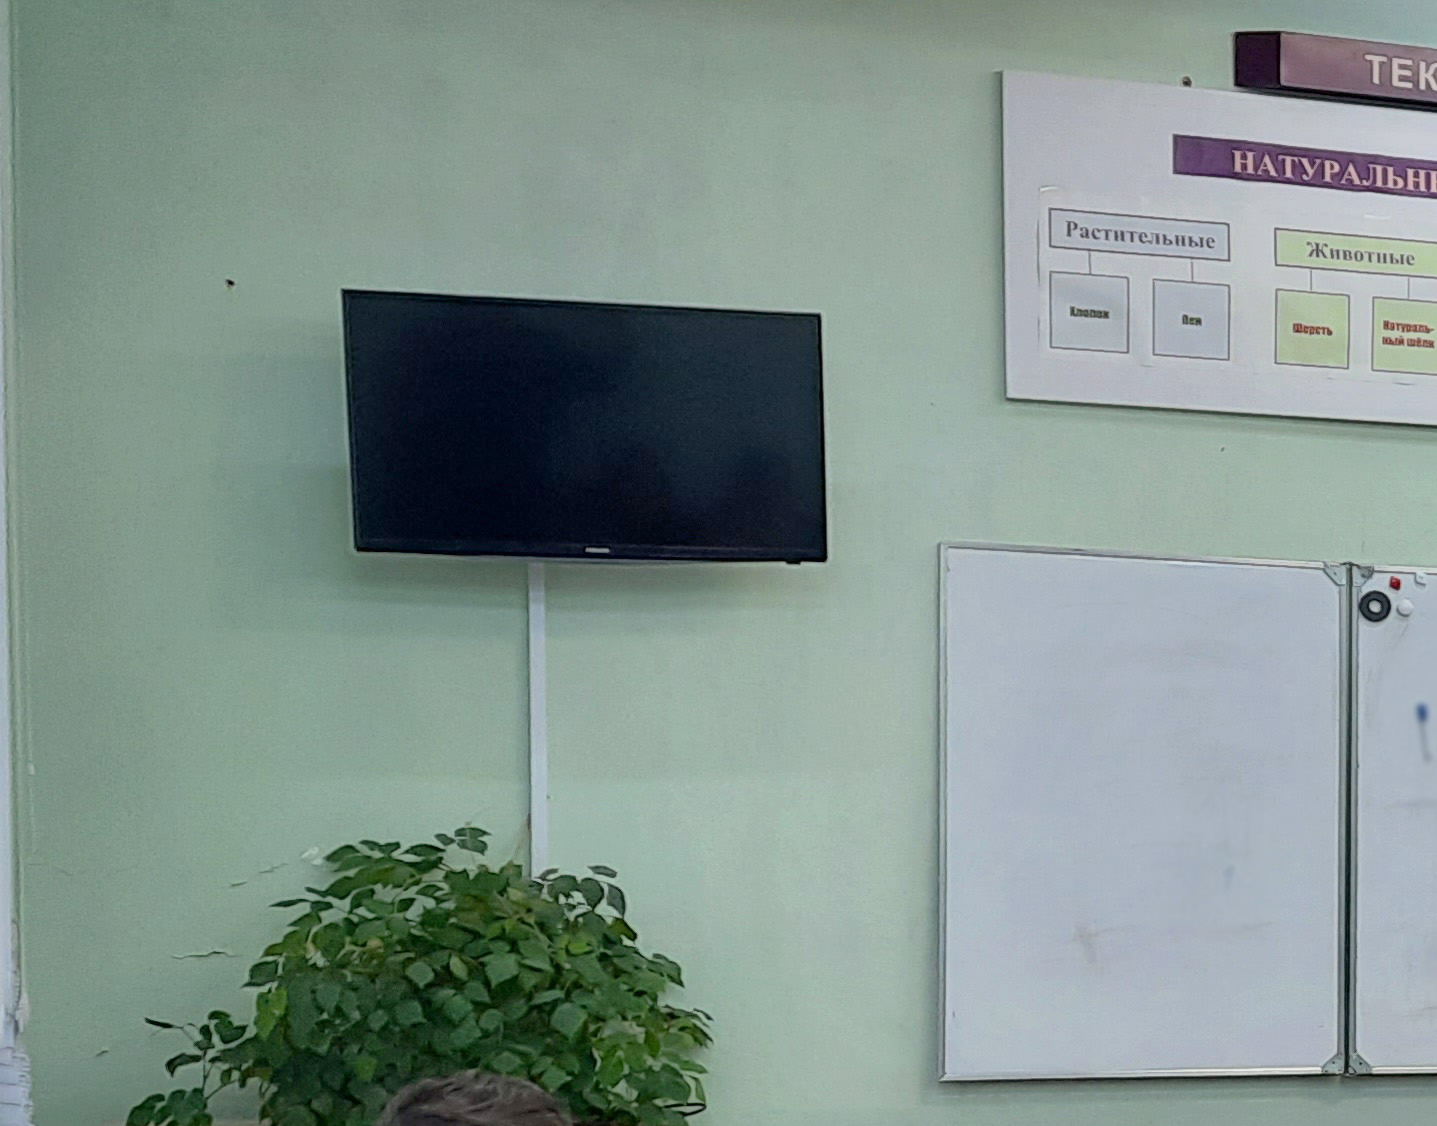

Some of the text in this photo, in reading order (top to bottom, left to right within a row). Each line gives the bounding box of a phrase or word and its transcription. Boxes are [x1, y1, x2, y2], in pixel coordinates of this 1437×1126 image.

[1065, 220, 1216, 249] Растительные
[1306, 241, 1415, 267] Животные
[1293, 322, 1333, 336] Шерсть
[1383, 320, 1435, 334] Натураль-
